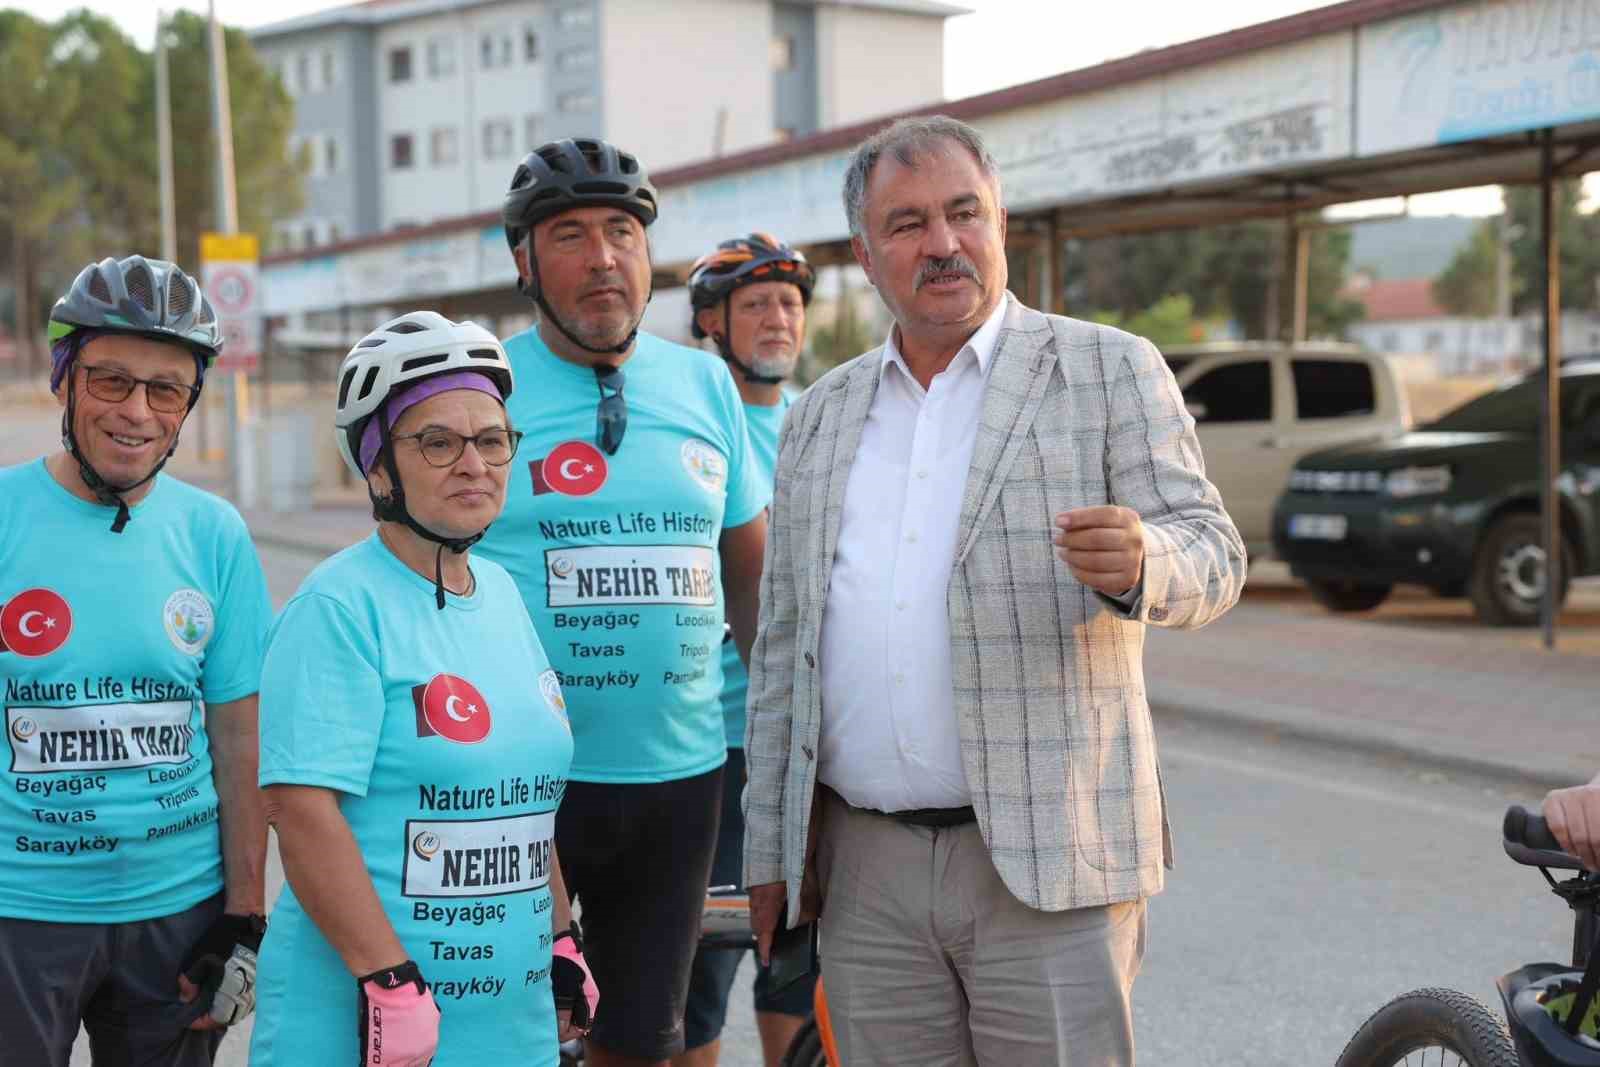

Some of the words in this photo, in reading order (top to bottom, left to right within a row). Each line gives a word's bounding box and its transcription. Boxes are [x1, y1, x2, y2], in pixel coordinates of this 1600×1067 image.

[538, 518, 613, 541] Nature
[616, 510, 657, 534] Life
[576, 559, 660, 598] NEHİR
[553, 611, 641, 632] Beyağaç
[567, 641, 626, 658] Tavas
[5, 677, 77, 702] Nature
[83, 676, 124, 700] Life
[39, 719, 129, 764] NEHİR
[15, 775, 107, 798] Beyağaç
[418, 783, 496, 811] Nature
[500, 776, 529, 807] Life
[31, 807, 97, 824] Tavas
[15, 834, 120, 857] Sarayköy
[440, 834, 521, 888] NEHİR
[413, 900, 507, 927] Beyağaç
[429, 940, 495, 961] Tavas
[424, 975, 506, 1000] rayköy
